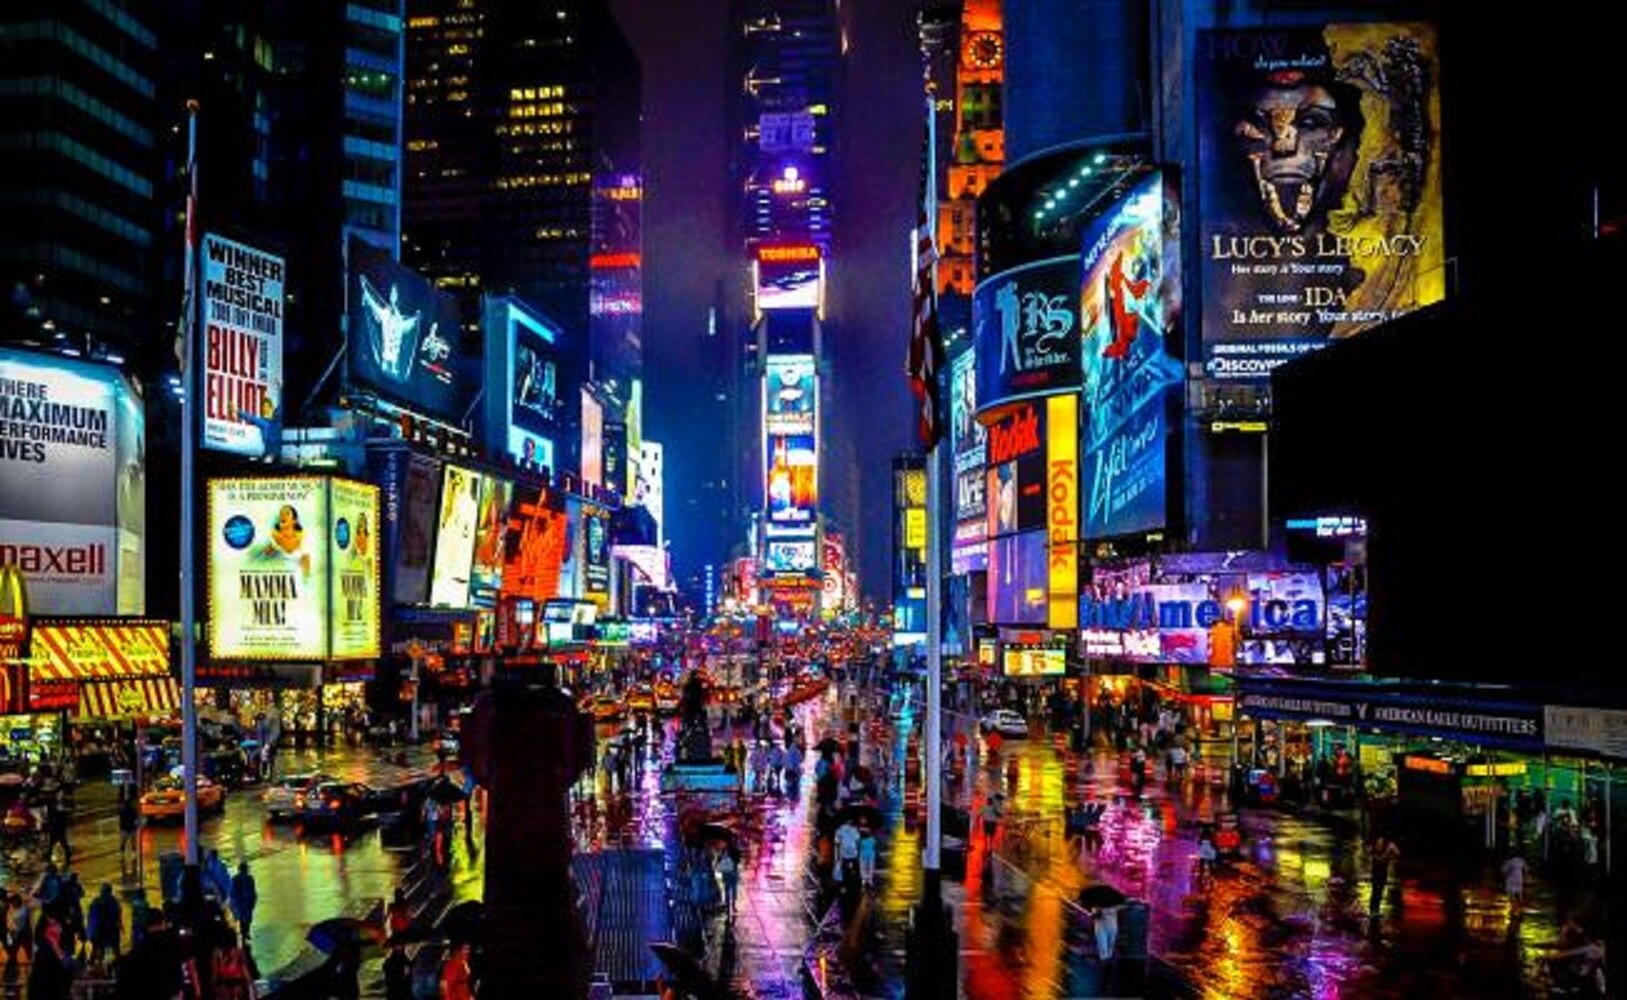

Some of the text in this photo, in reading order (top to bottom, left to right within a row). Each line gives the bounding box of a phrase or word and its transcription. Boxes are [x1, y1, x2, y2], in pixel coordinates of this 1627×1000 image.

[759, 247, 818, 260] TOSHIBA
[1212, 235, 1426, 259] LUCY'S LEGACY
[206, 240, 281, 283] WINNER
[225, 268, 264, 295] BEST
[207, 281, 281, 319] MUSICAL
[1304, 287, 1345, 306] IDA
[1232, 310, 1246, 323] Is
[1249, 309, 1273, 324] her
[1276, 312, 1310, 326] story
[1316, 309, 1346, 323] Your
[207, 324, 259, 379] BILLY
[0, 377, 47, 400] HERE
[207, 373, 268, 426] ELLIOT
[0, 420, 107, 449] ERFORMANCE
[0, 439, 46, 463] IVES
[1051, 460, 1073, 568] Kodak
[239, 575, 298, 598] MAMMA
[252, 601, 287, 625] MIA!
[1375, 706, 1425, 723] AMERICAN
[1427, 710, 1460, 727] EAGLE
[1461, 714, 1537, 735] OUTFITTERS
